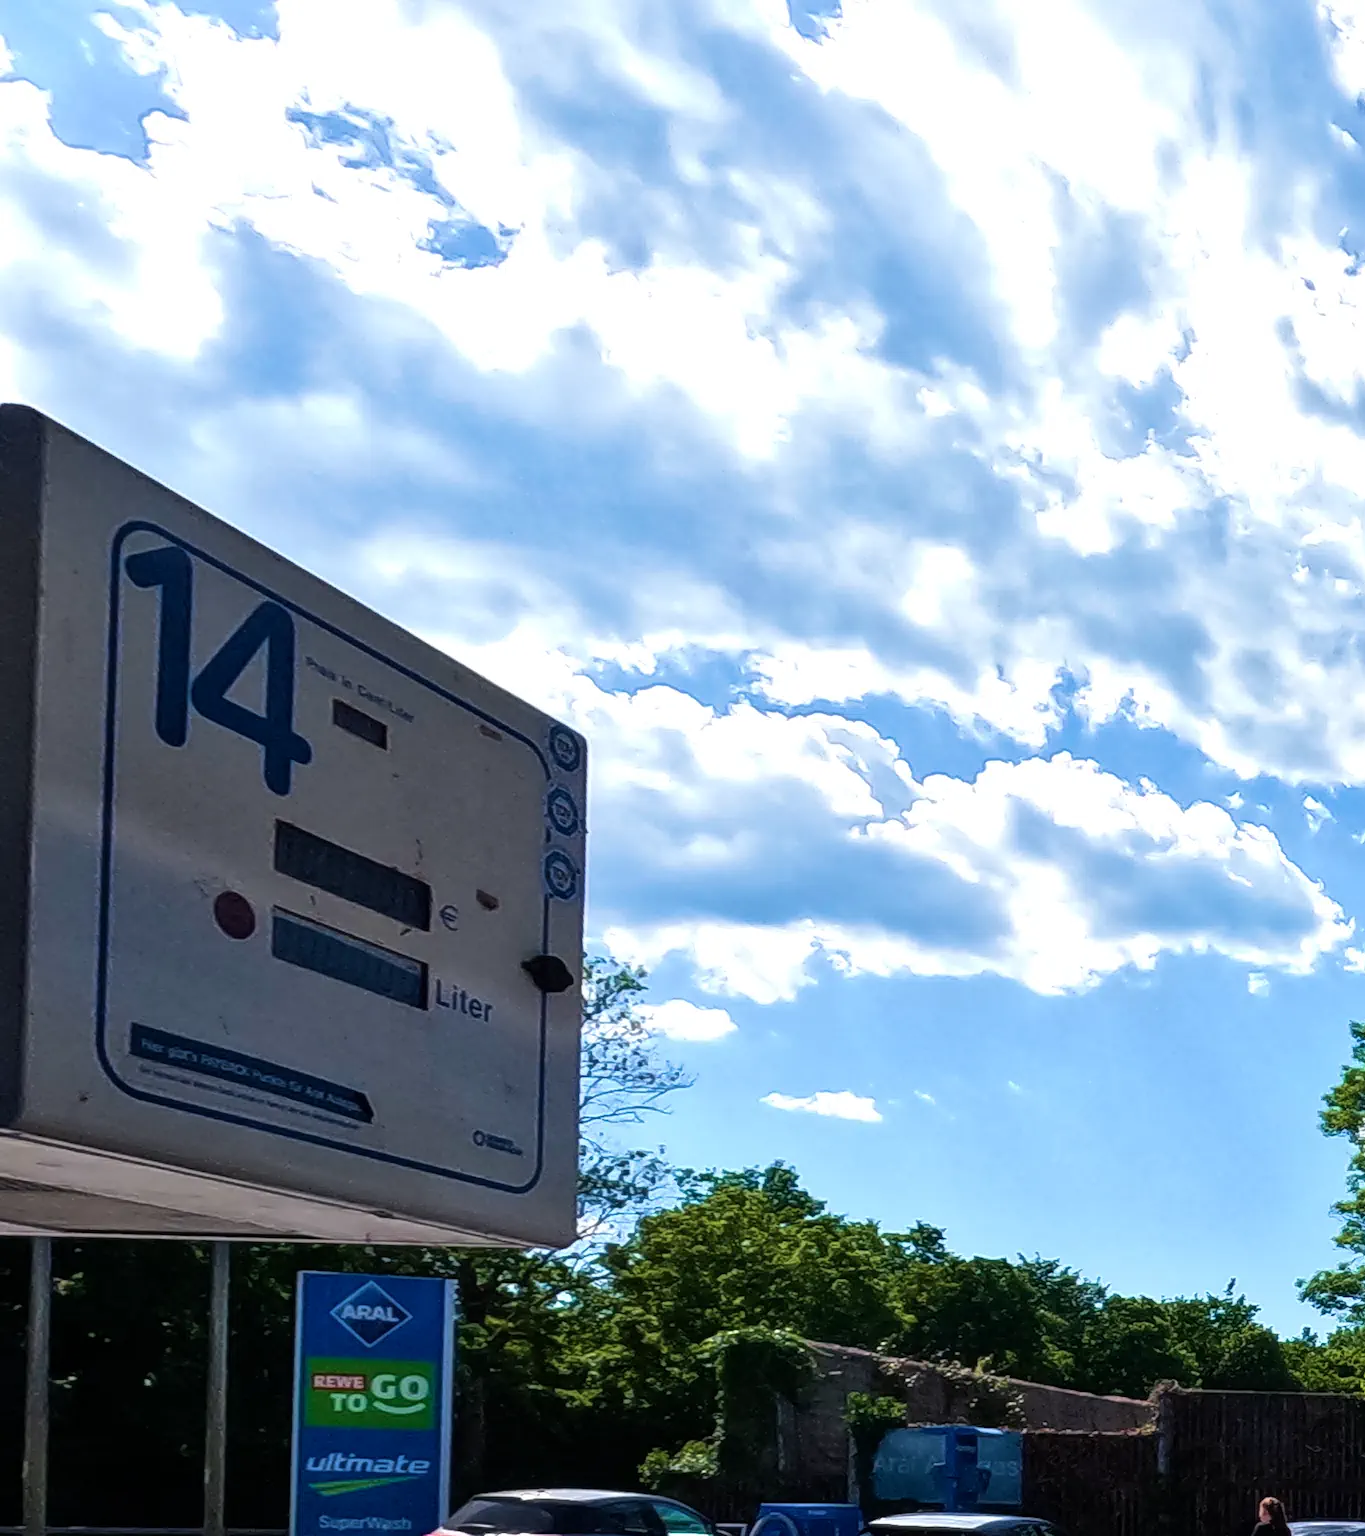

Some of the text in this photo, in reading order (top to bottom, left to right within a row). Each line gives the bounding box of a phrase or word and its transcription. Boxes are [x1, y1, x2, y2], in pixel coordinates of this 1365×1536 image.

[124, 545, 312, 796] 14
[435, 978, 495, 1024] Liter
[341, 1303, 400, 1323] ARAL
[313, 1373, 430, 1413] REWE TO GO
[305, 1450, 431, 1476] ultimate
[318, 1514, 413, 1531] SuperWash
